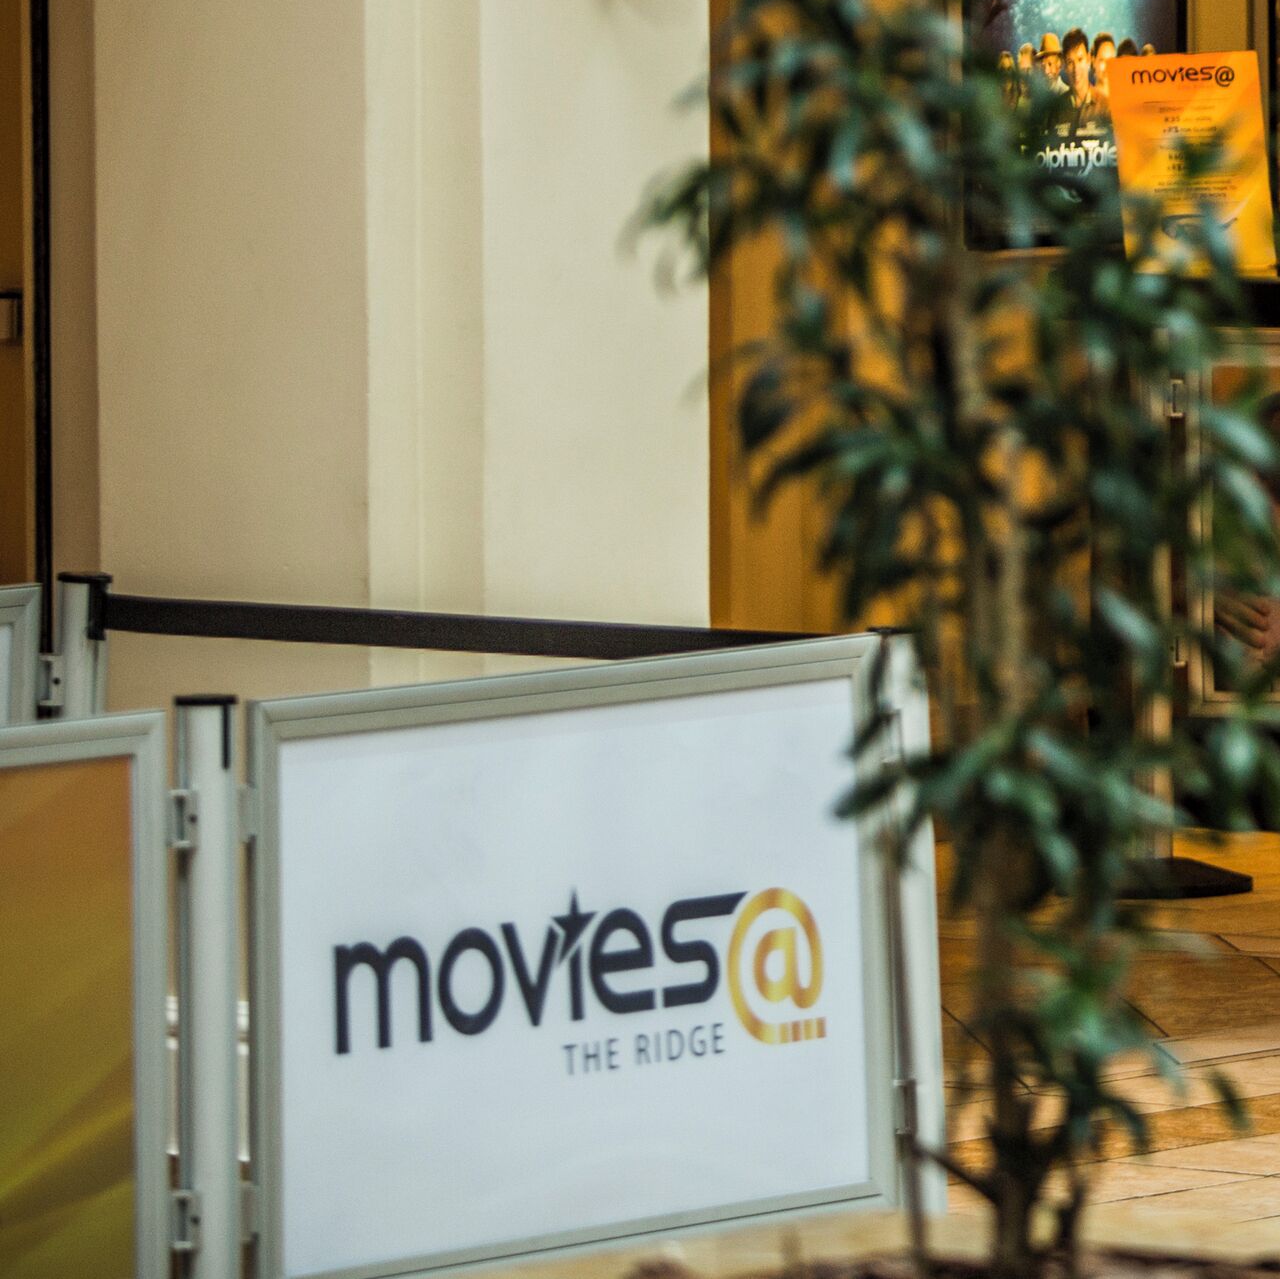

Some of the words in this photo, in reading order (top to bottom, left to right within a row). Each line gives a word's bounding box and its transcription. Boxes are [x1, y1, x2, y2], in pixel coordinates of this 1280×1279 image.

[1131, 65, 1235, 88] movies@
[1035, 141, 1085, 174] olphin
[332, 884, 828, 1057] movies@
[562, 1037, 620, 1076] THE
[634, 1022, 727, 1068] RIDGE
